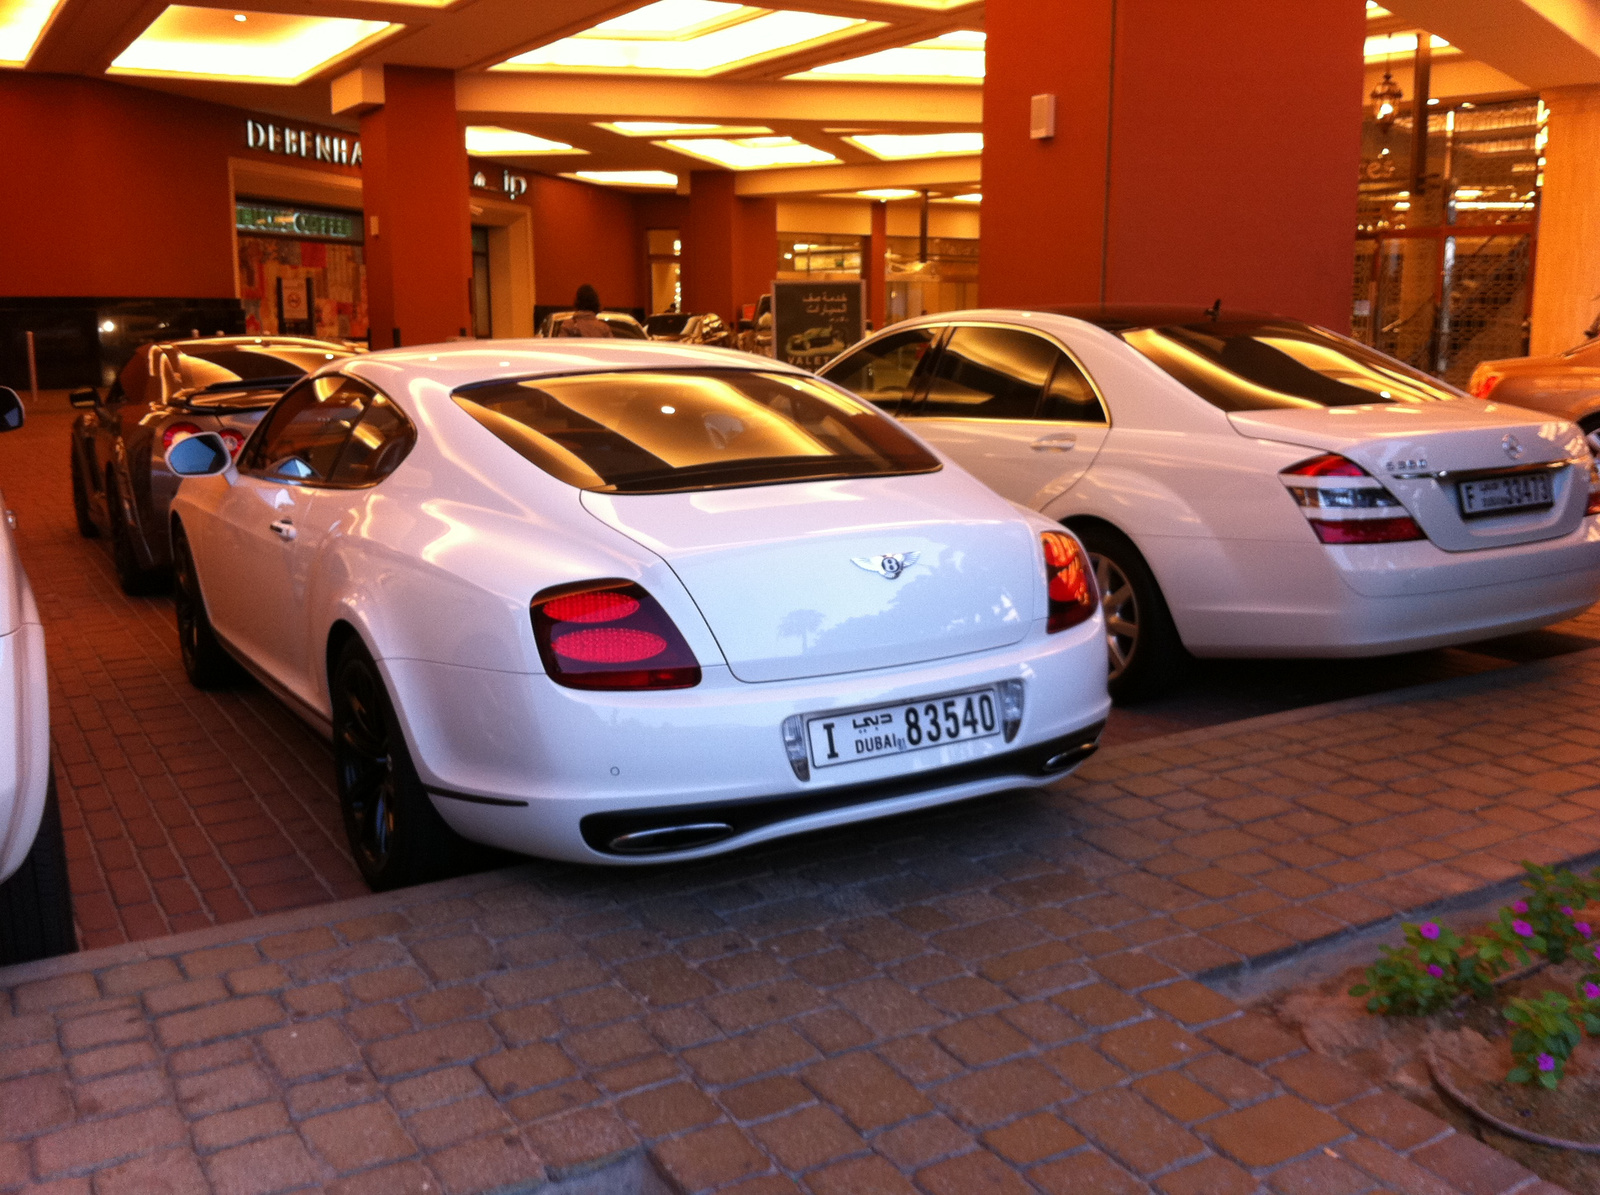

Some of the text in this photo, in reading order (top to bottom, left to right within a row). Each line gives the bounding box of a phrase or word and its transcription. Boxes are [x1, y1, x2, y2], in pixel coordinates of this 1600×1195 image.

[787, 356, 830, 365] VALET
[852, 713, 893, 734] دبي
[905, 694, 995, 746] 83540
[823, 723, 839, 759] I
[855, 733, 897, 754] DUBAI
